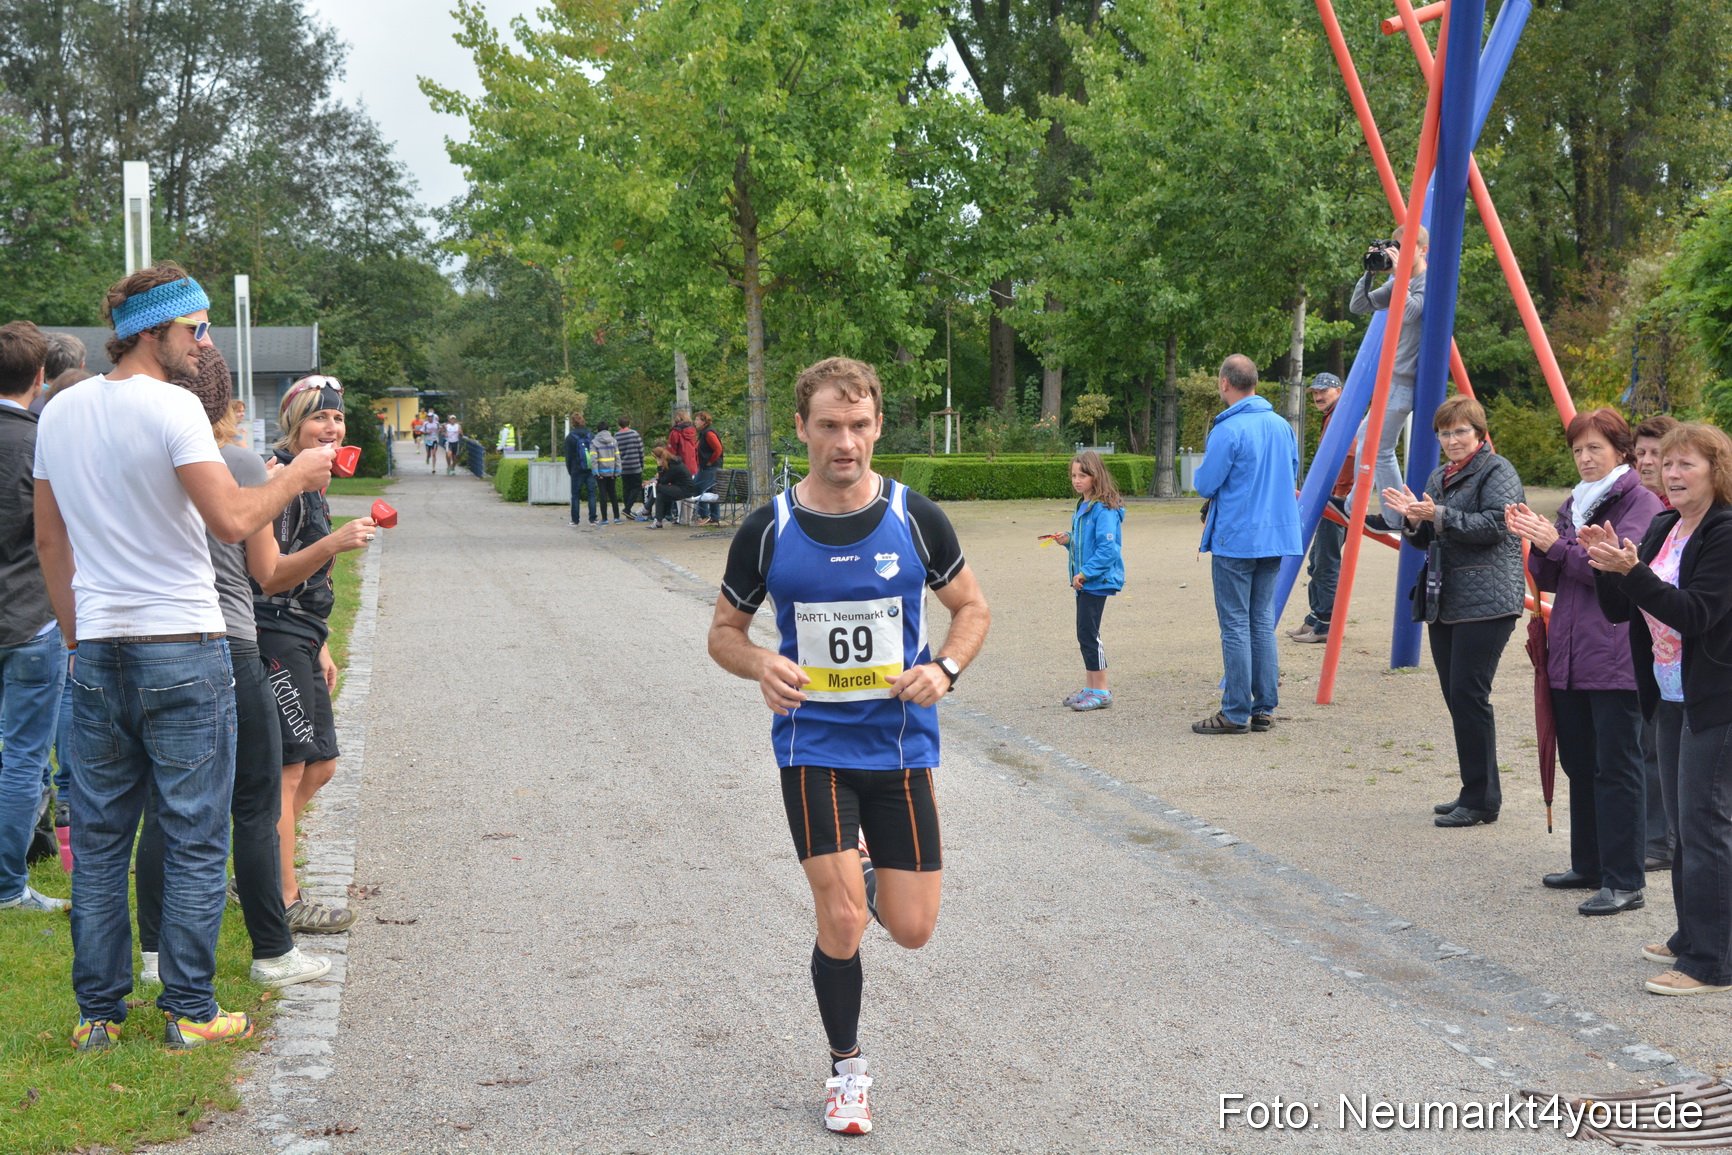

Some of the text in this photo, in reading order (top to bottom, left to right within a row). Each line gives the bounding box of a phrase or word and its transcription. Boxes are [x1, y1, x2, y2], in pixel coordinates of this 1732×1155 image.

[830, 555, 854, 563] CRAFT
[797, 610, 884, 622] PARTL Neumarkt
[828, 625, 873, 664] 69
[828, 672, 876, 688] Marcel
